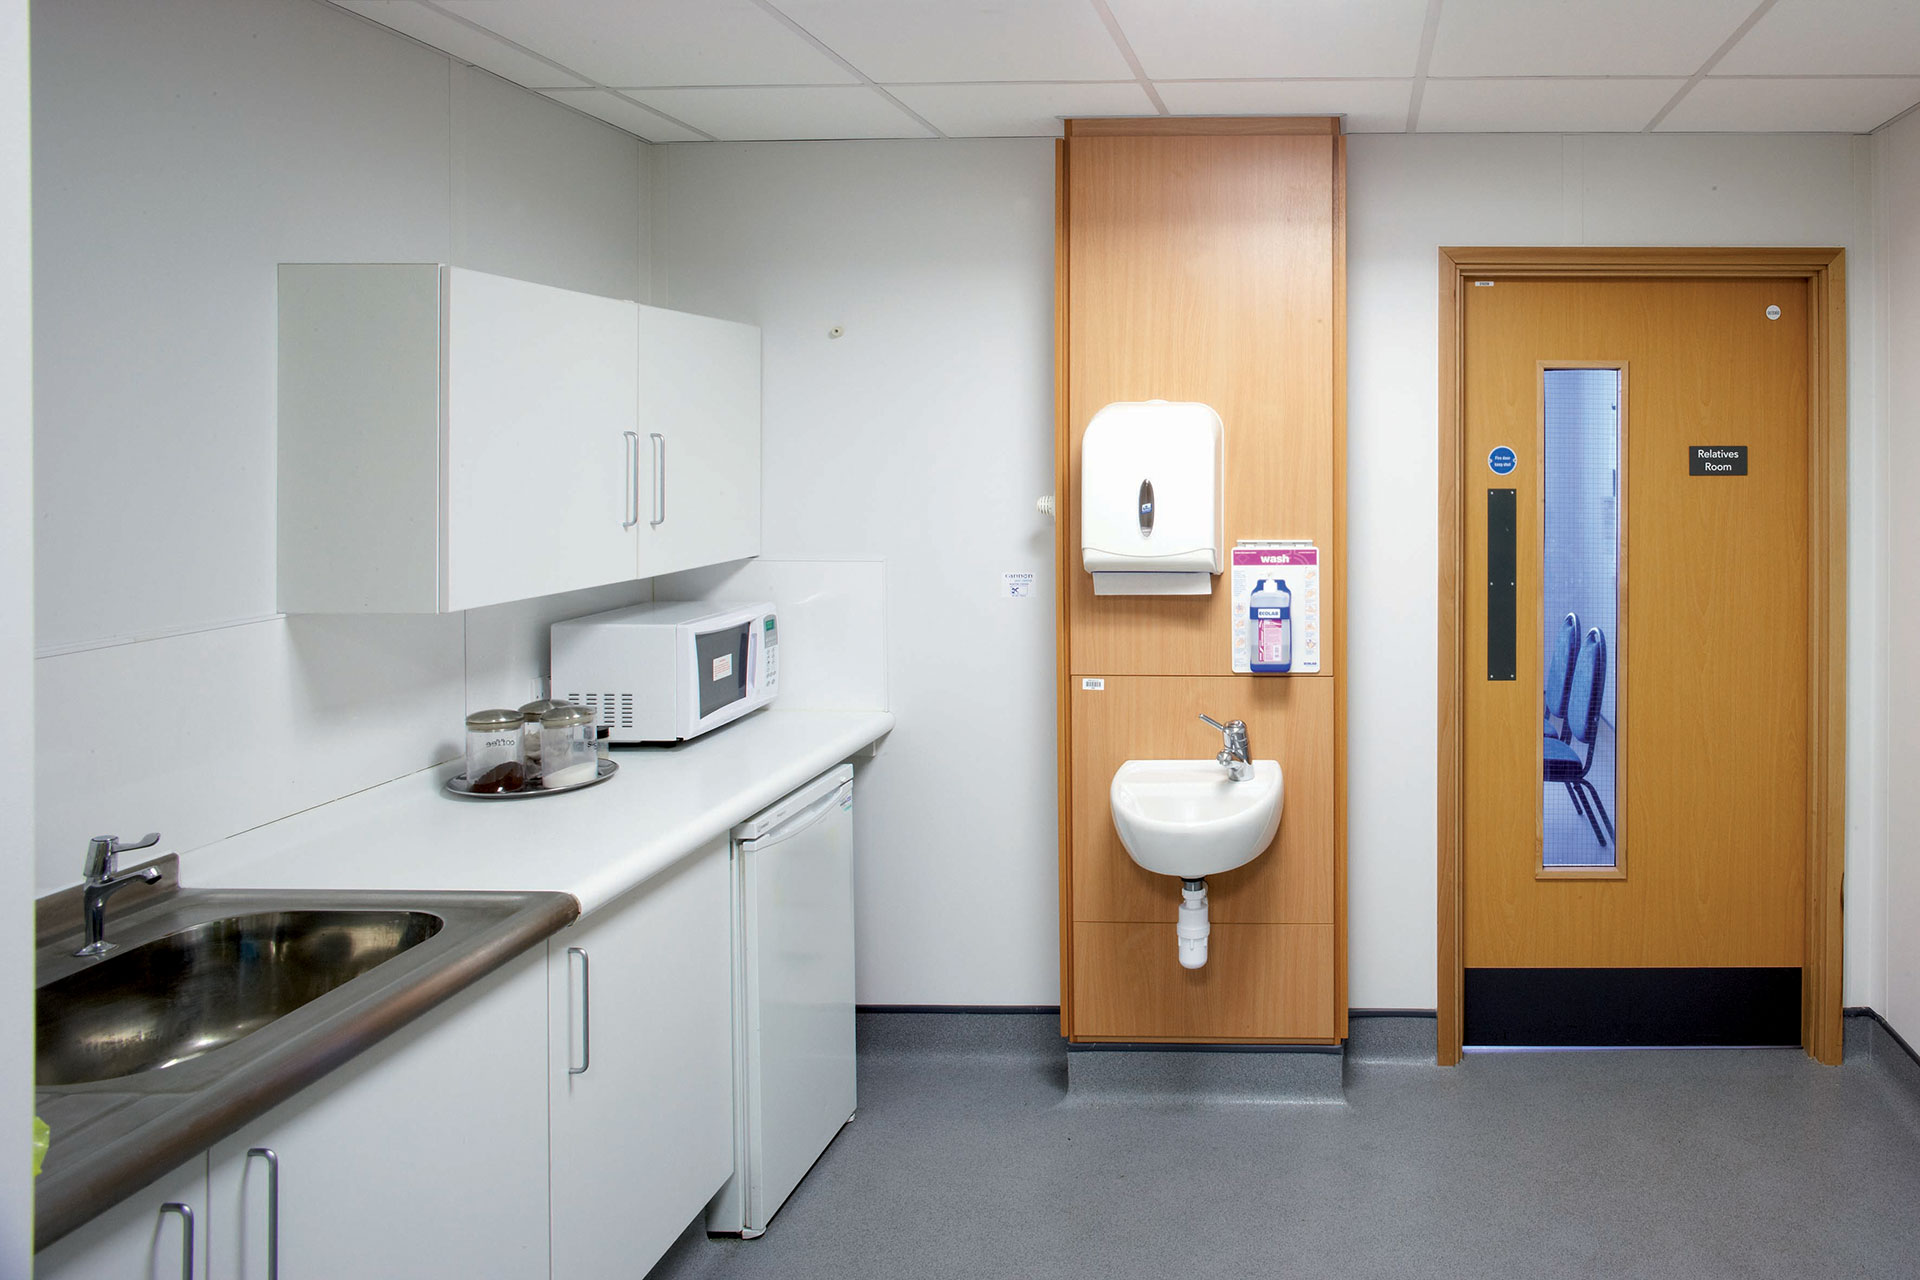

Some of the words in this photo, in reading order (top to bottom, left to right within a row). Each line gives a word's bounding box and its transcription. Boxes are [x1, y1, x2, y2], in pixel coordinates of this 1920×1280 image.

[1697, 449, 1739, 459] Relatives
[1704, 461, 1732, 471] Room
[1260, 553, 1290, 564] wash
